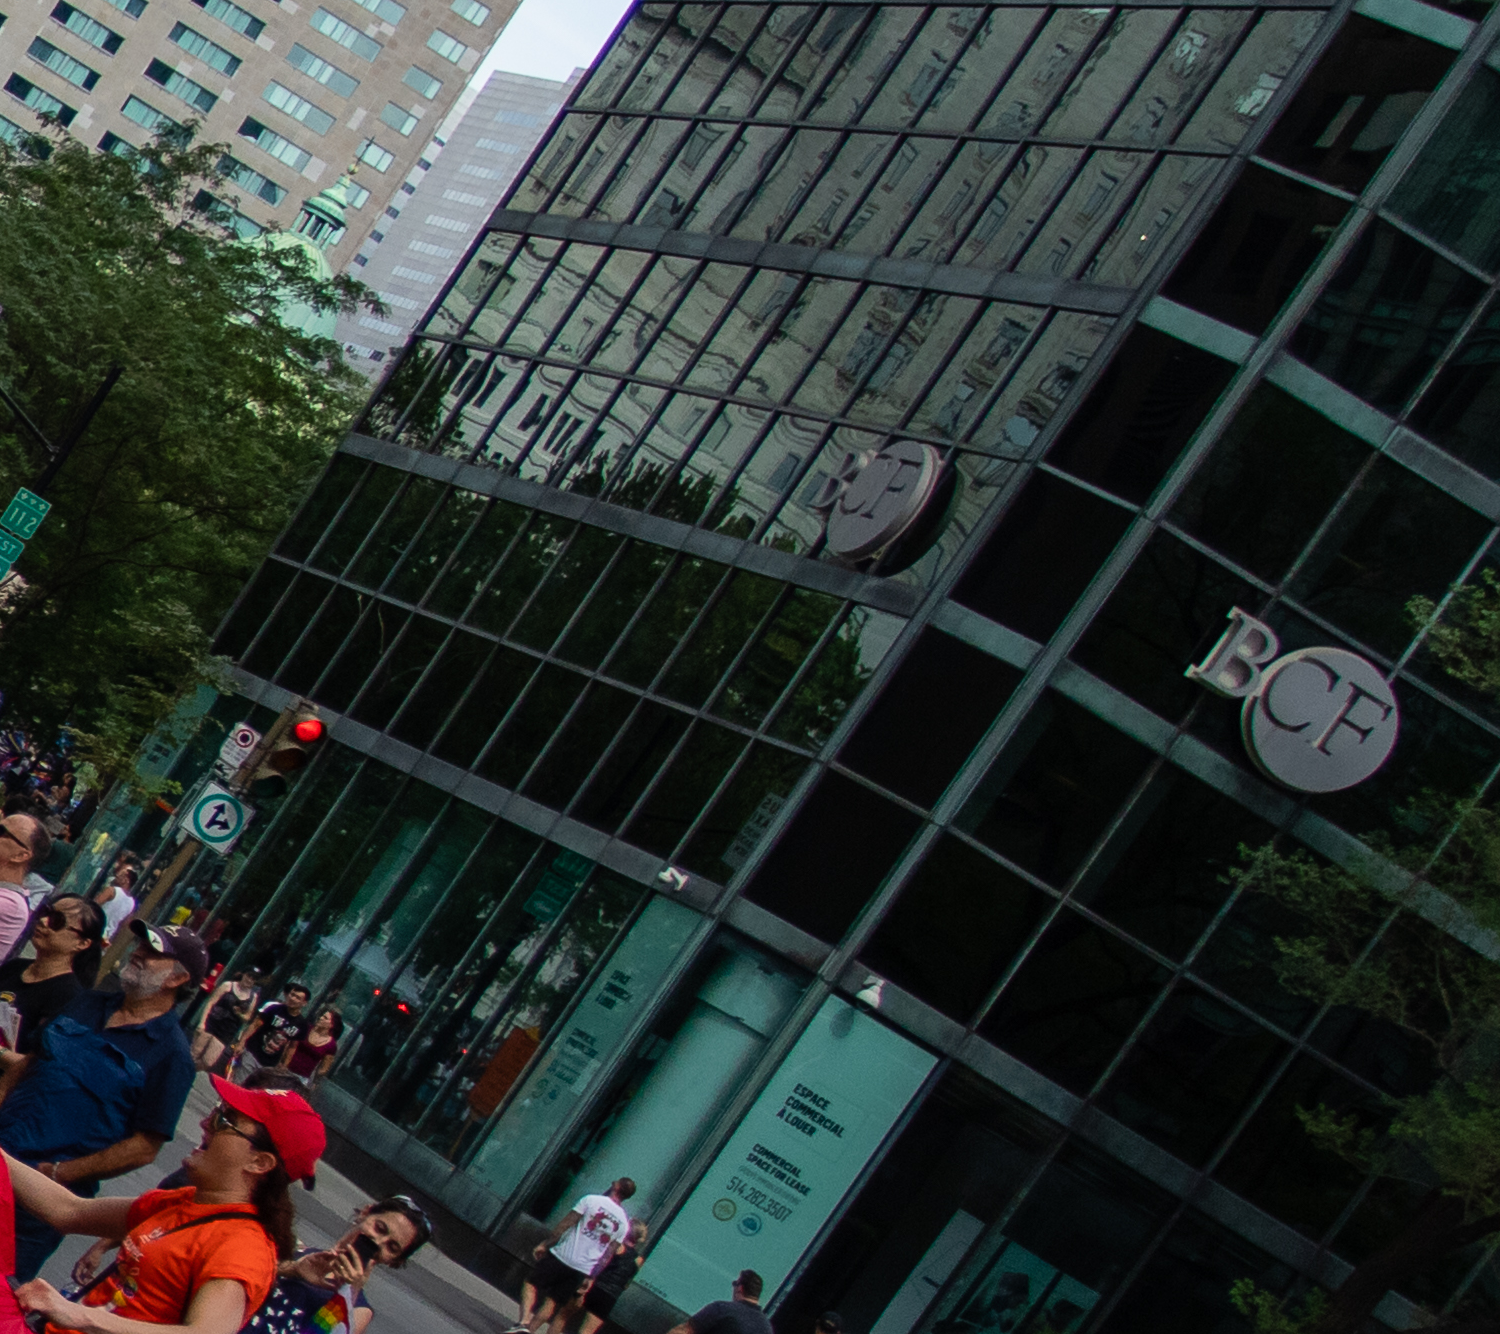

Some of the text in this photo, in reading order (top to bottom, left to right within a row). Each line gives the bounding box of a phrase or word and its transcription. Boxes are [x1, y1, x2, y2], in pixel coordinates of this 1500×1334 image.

[811, 445, 927, 529] BCF
[9, 508, 37, 533] 112
[1186, 606, 1393, 758] BCF
[785, 1096, 845, 1138] COMMERCIAL
[793, 1083, 830, 1110] ESPACE
[784, 1111, 817, 1138] LOUER
[746, 1153, 771, 1173] SPACE
[770, 1167, 786, 1182] FOR
[784, 1175, 811, 1196] LEASE
[752, 1144, 801, 1177] COMMERCIAL
[726, 1176, 793, 1222] 514.282.3507
